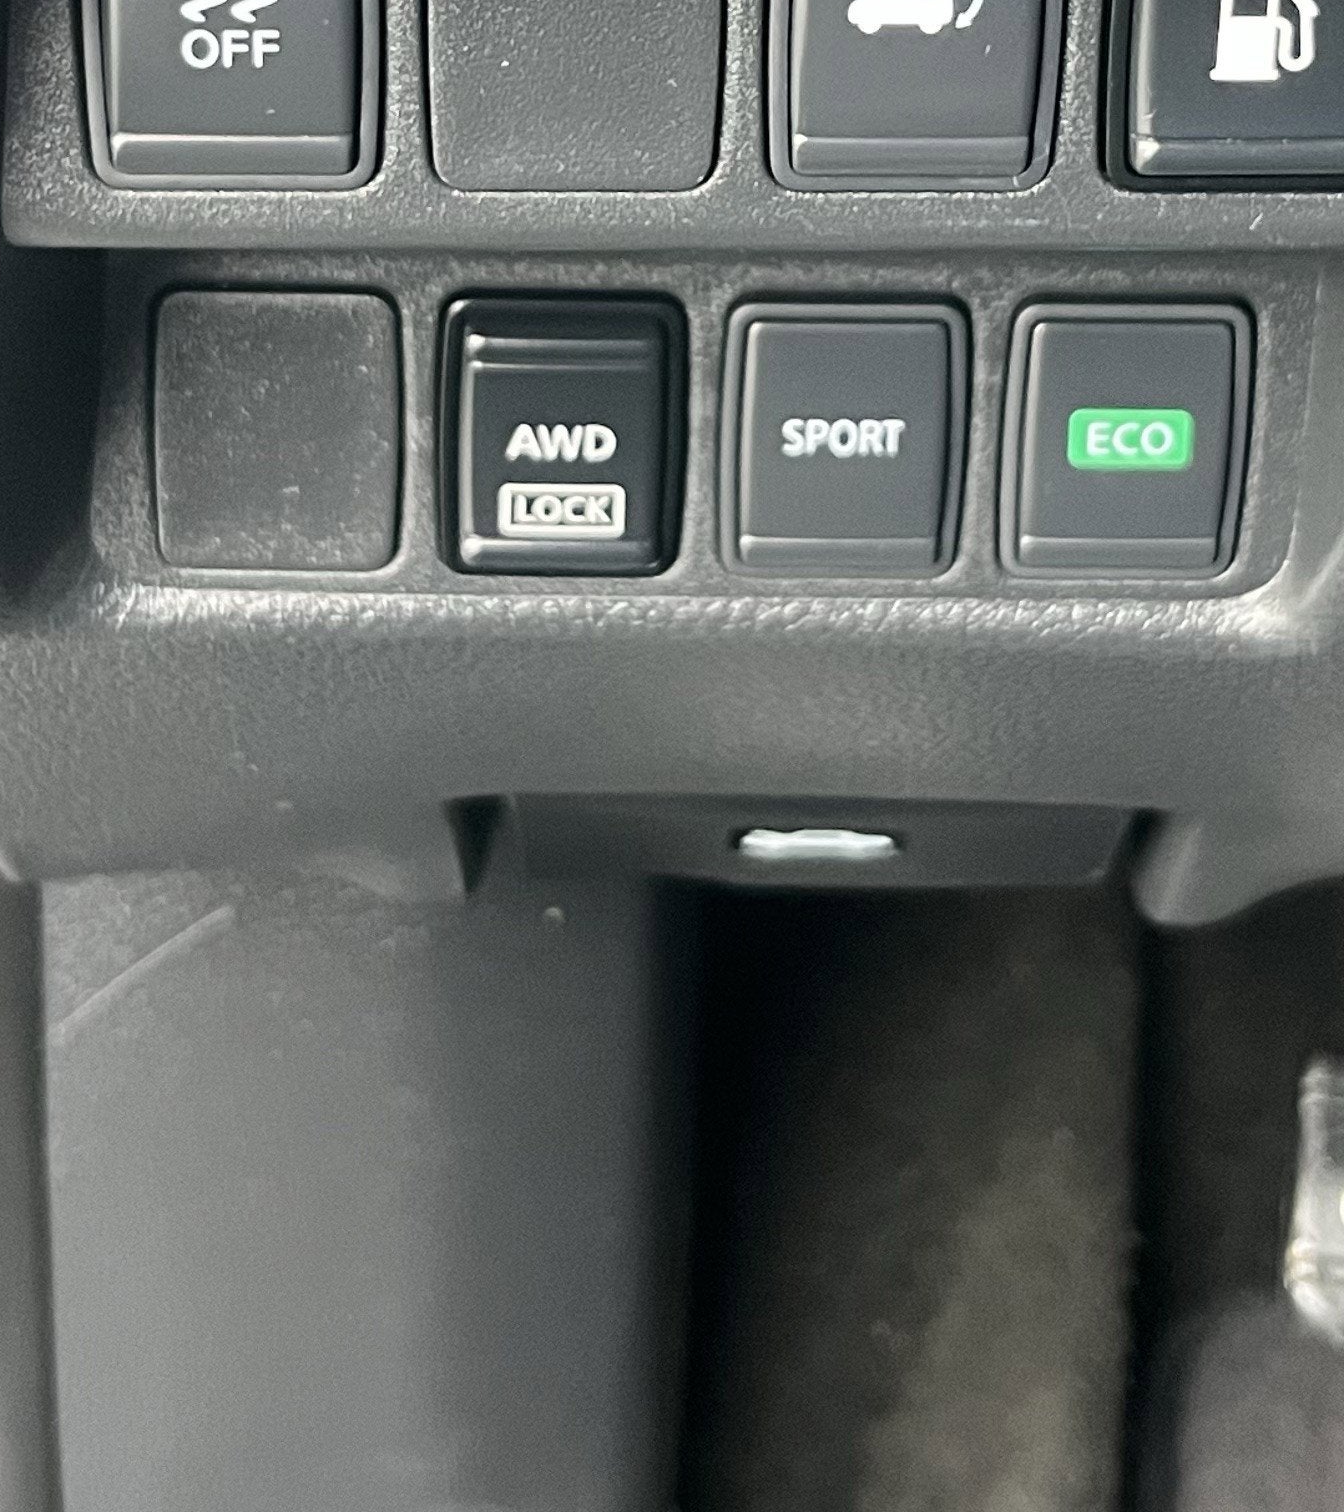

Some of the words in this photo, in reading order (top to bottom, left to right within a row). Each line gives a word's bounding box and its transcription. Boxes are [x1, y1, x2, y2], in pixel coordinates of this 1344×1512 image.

[180, 28, 281, 70] OFF
[505, 423, 617, 463] AWD
[781, 418, 906, 458] SPORT
[1085, 422, 1173, 456] ECO
[513, 493, 612, 524] LOCK
